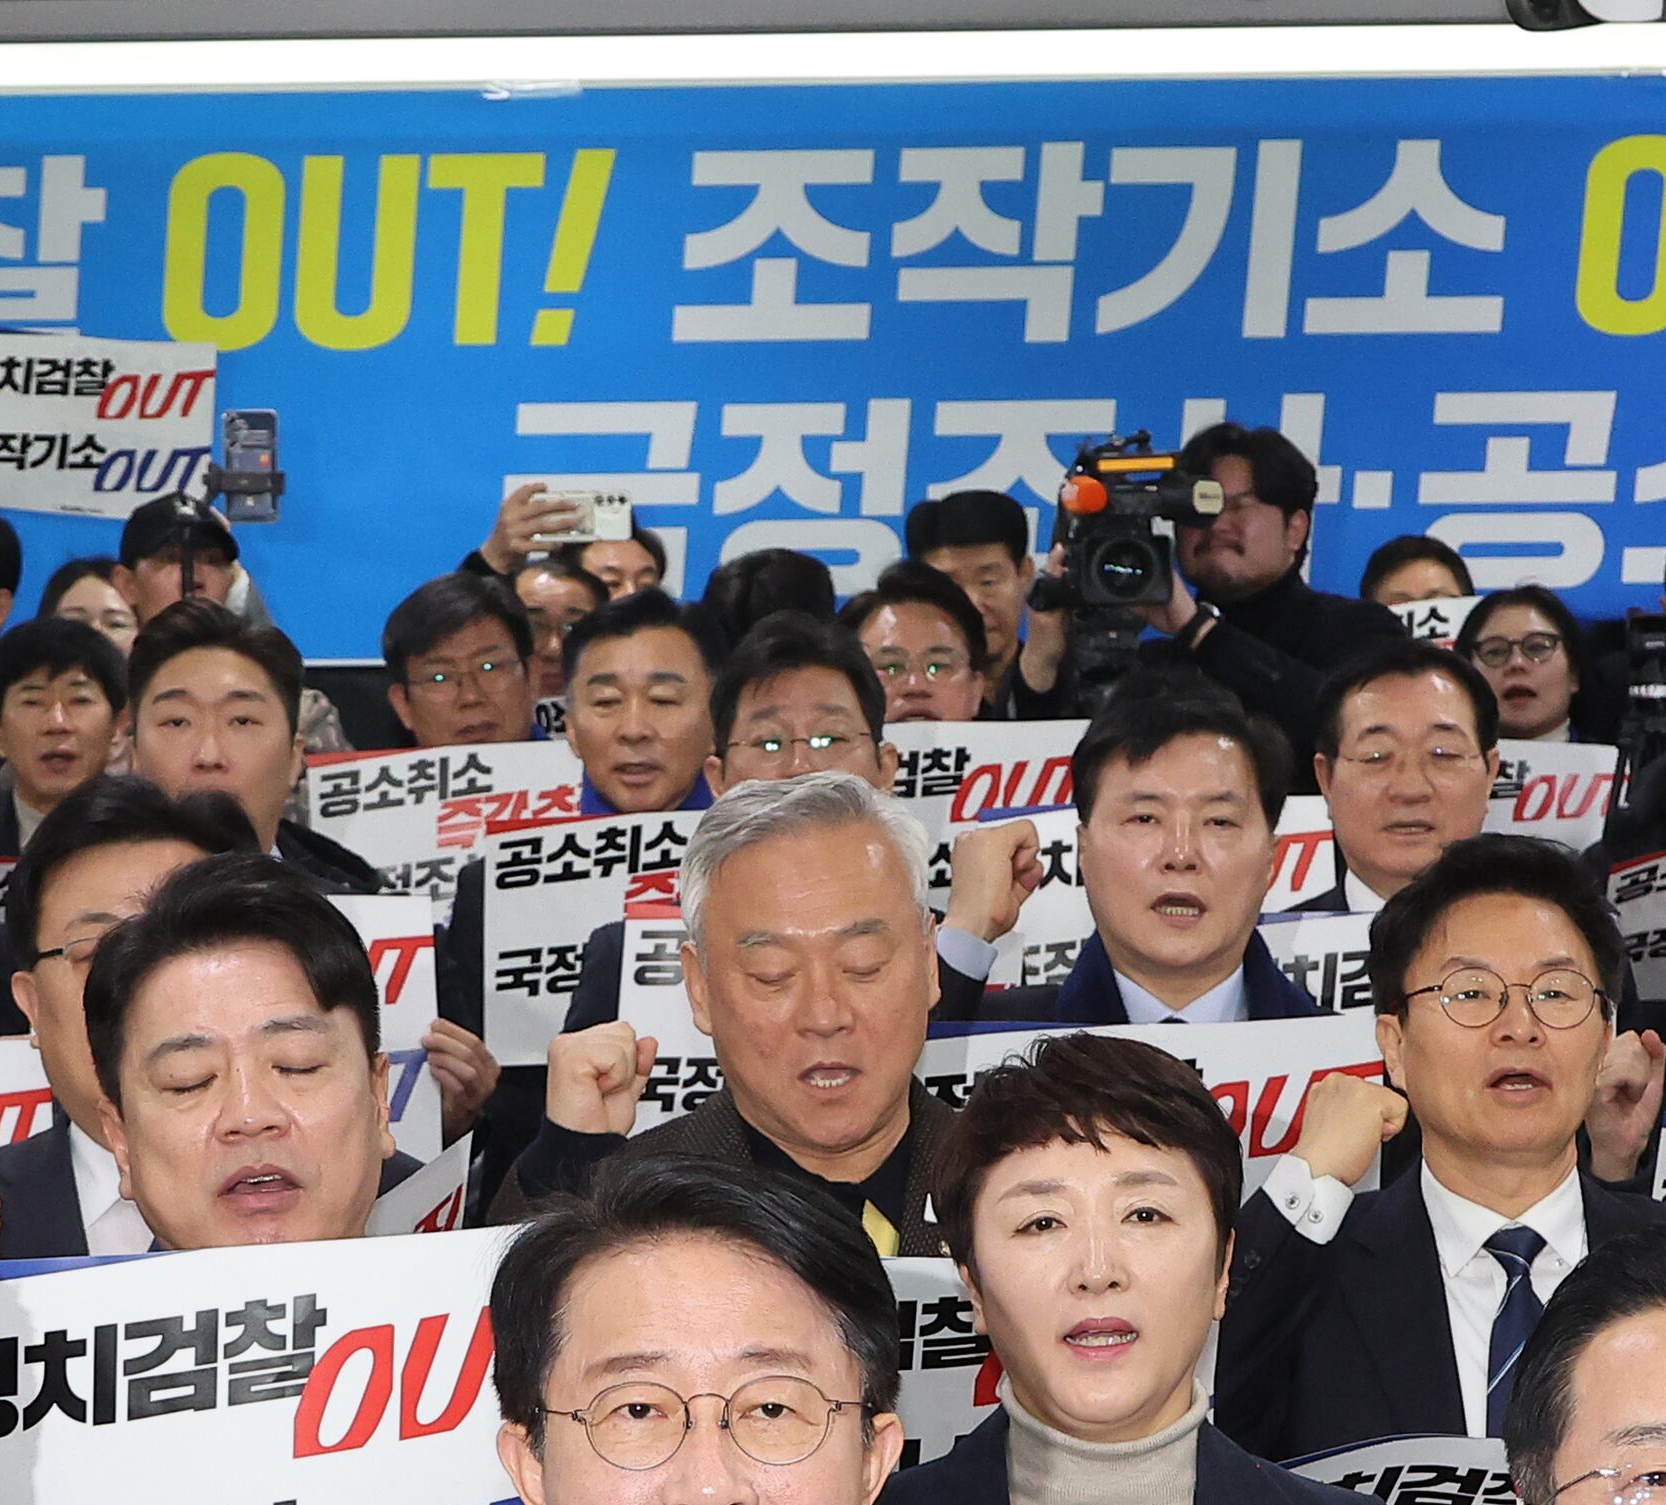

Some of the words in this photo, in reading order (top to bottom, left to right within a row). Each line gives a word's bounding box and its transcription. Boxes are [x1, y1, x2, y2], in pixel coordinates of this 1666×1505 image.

[160, 148, 617, 353] OUT!
[669, 137, 1507, 343] 조작기소
[95, 369, 217, 420] OUT
[91, 446, 213, 493] OUT
[319, 752, 494, 819] 공소취소
[495, 821, 689, 890] 공소취소
[292, 1304, 501, 1459] OU
